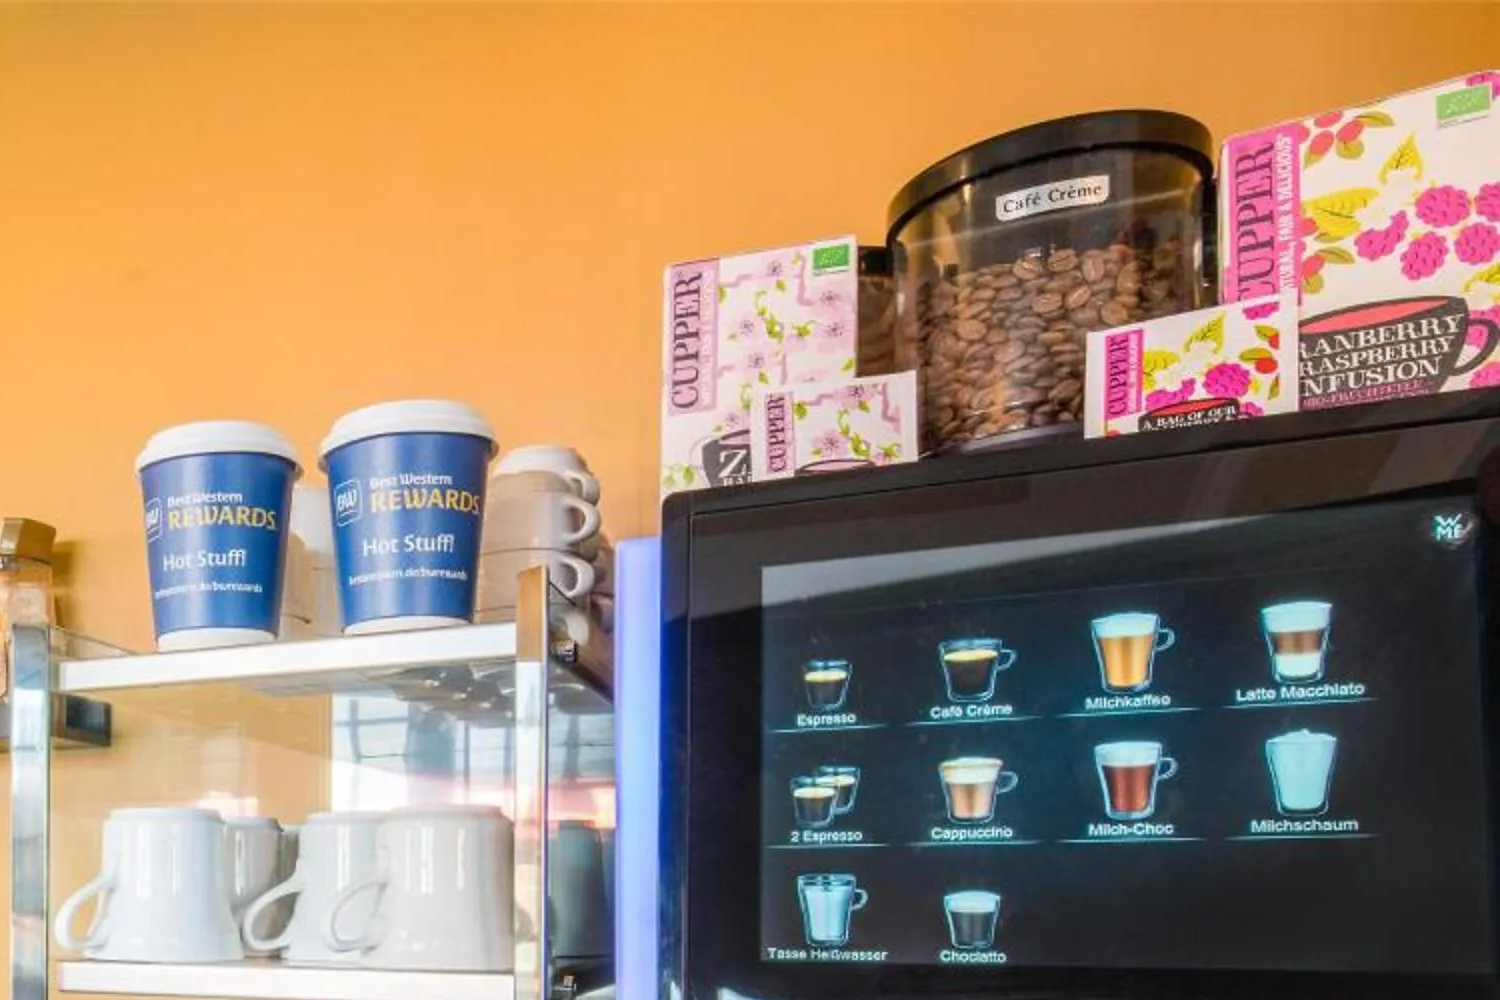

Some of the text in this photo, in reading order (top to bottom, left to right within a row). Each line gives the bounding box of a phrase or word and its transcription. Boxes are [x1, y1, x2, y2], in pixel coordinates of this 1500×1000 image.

[1003, 184, 1102, 213] Café Crème
[1235, 141, 1277, 301] CUPPER
[671, 271, 703, 409] CUPPER
[1300, 313, 1465, 359] ANBERRY
[1300, 335, 1456, 376] RASPBERRY
[1300, 356, 1443, 396] NFUSION
[766, 395, 788, 473] CUPPER
[719, 449, 747, 478] Z
[369, 472, 453, 489] Best Western
[194, 491, 243, 505] Western
[370, 488, 479, 514] REWARDS
[167, 505, 277, 531] REWARDS
[363, 533, 455, 557] Hot Stuff!
[163, 548, 246, 572] Hot Stuff!
[1085, 693, 1171, 710] Milchkaffee
[1235, 682, 1365, 702] Latte Macchiato
[796, 712, 857, 728] Espresso
[930, 706, 963, 719] Café
[790, 830, 863, 845] 2 Espresso
[931, 827, 1013, 841] Cappuccino
[1088, 822, 1175, 836] Milch-Choc
[1251, 819, 1359, 833] Milchschaum
[767, 947, 807, 960] Tasse
